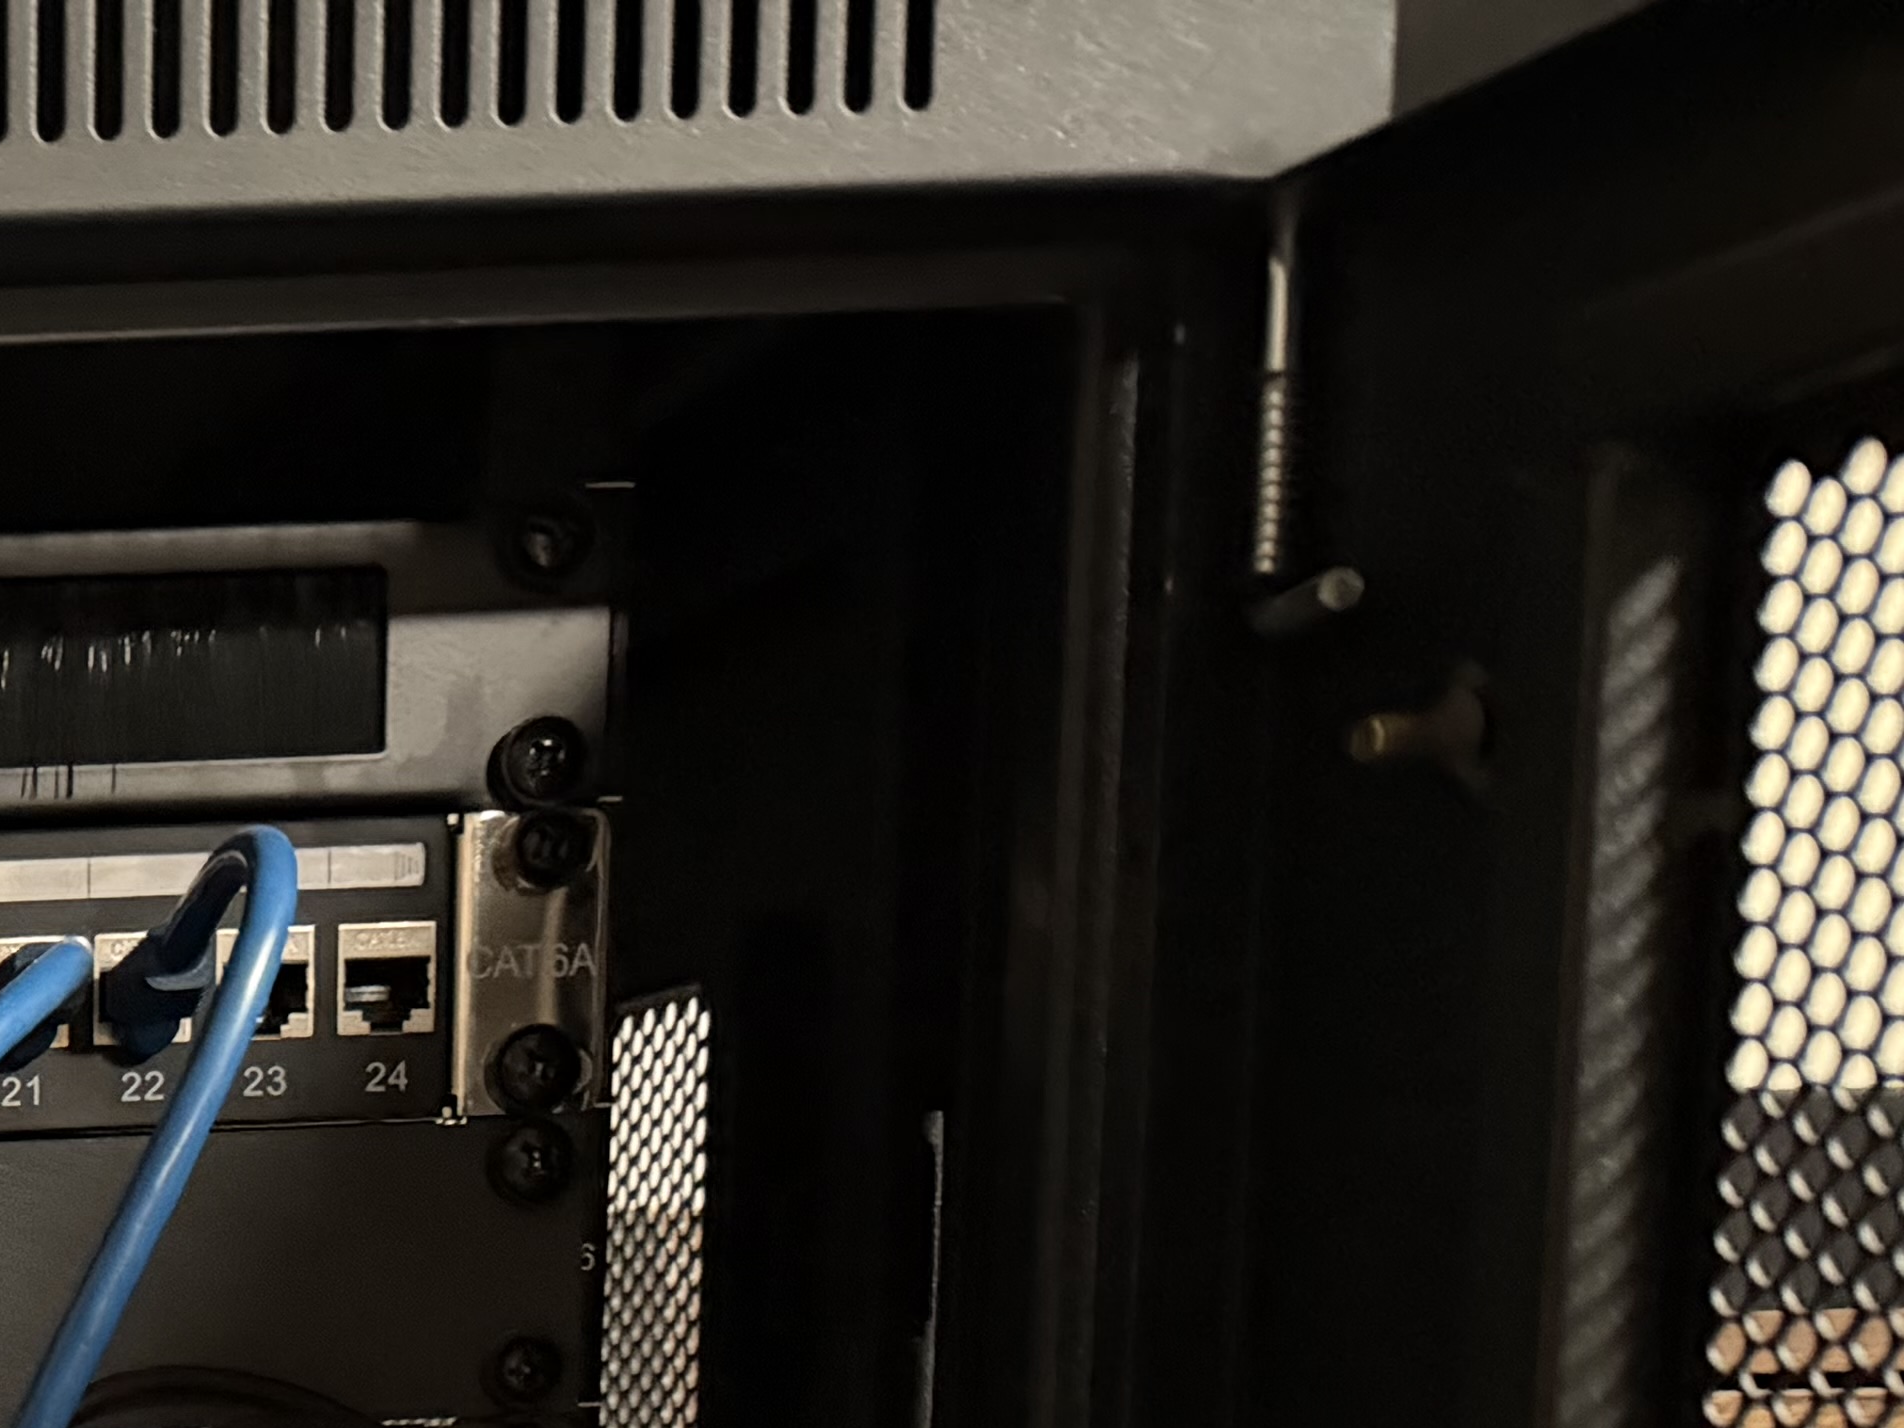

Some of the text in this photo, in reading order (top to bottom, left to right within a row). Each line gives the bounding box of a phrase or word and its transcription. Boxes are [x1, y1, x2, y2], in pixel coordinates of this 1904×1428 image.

[468, 943, 597, 980] CAT 6A
[1, 1074, 40, 1106] 21
[121, 1072, 165, 1101] 22
[243, 1066, 288, 1096] 23
[365, 1063, 408, 1092] 24
